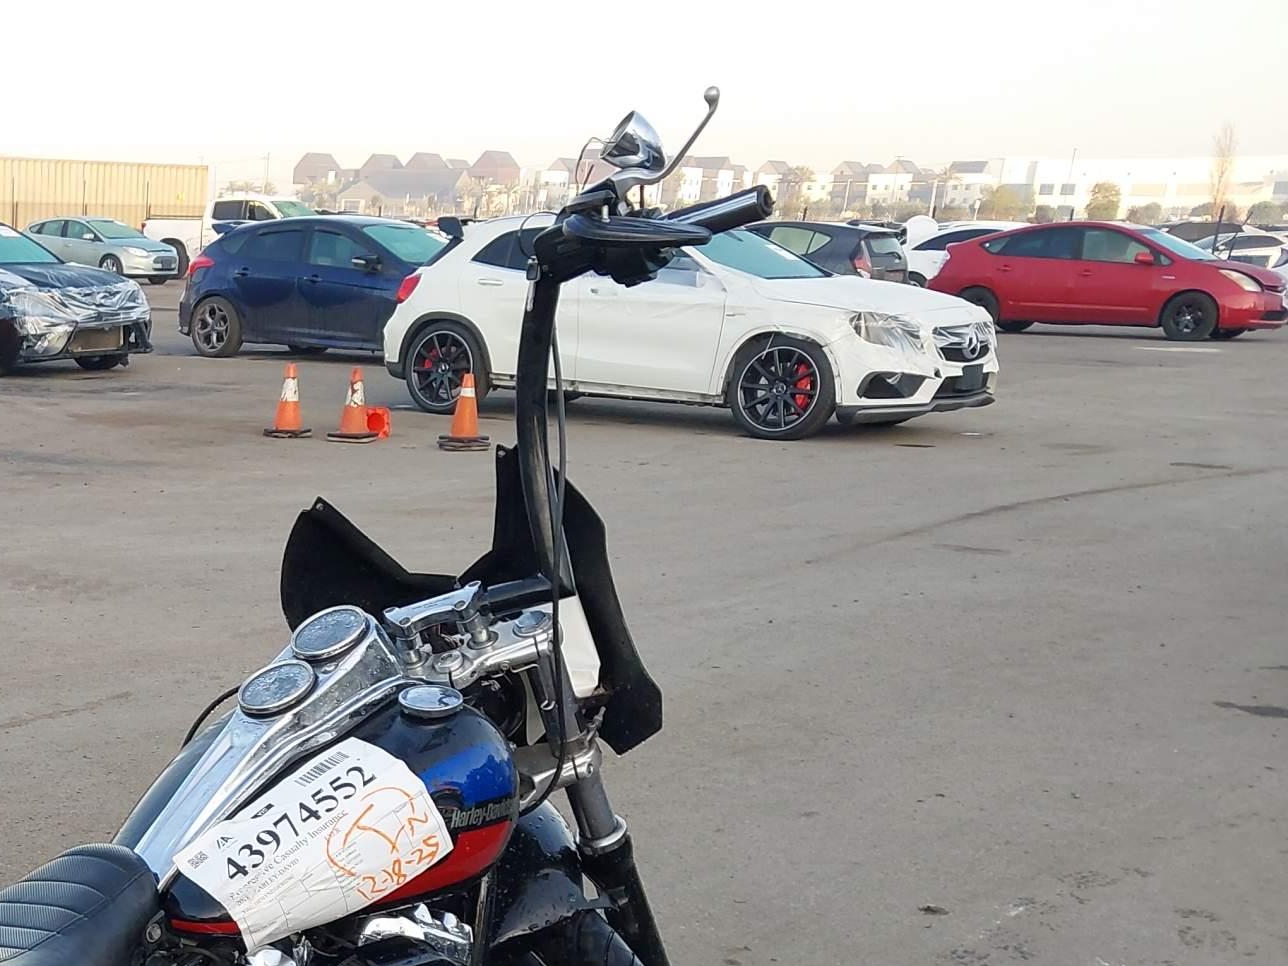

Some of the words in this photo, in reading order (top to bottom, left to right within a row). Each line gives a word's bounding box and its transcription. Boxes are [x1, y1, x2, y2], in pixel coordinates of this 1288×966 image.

[226, 765, 377, 880] 43974552
[274, 836, 310, 865] Casualty
[307, 809, 348, 840] Insurance
